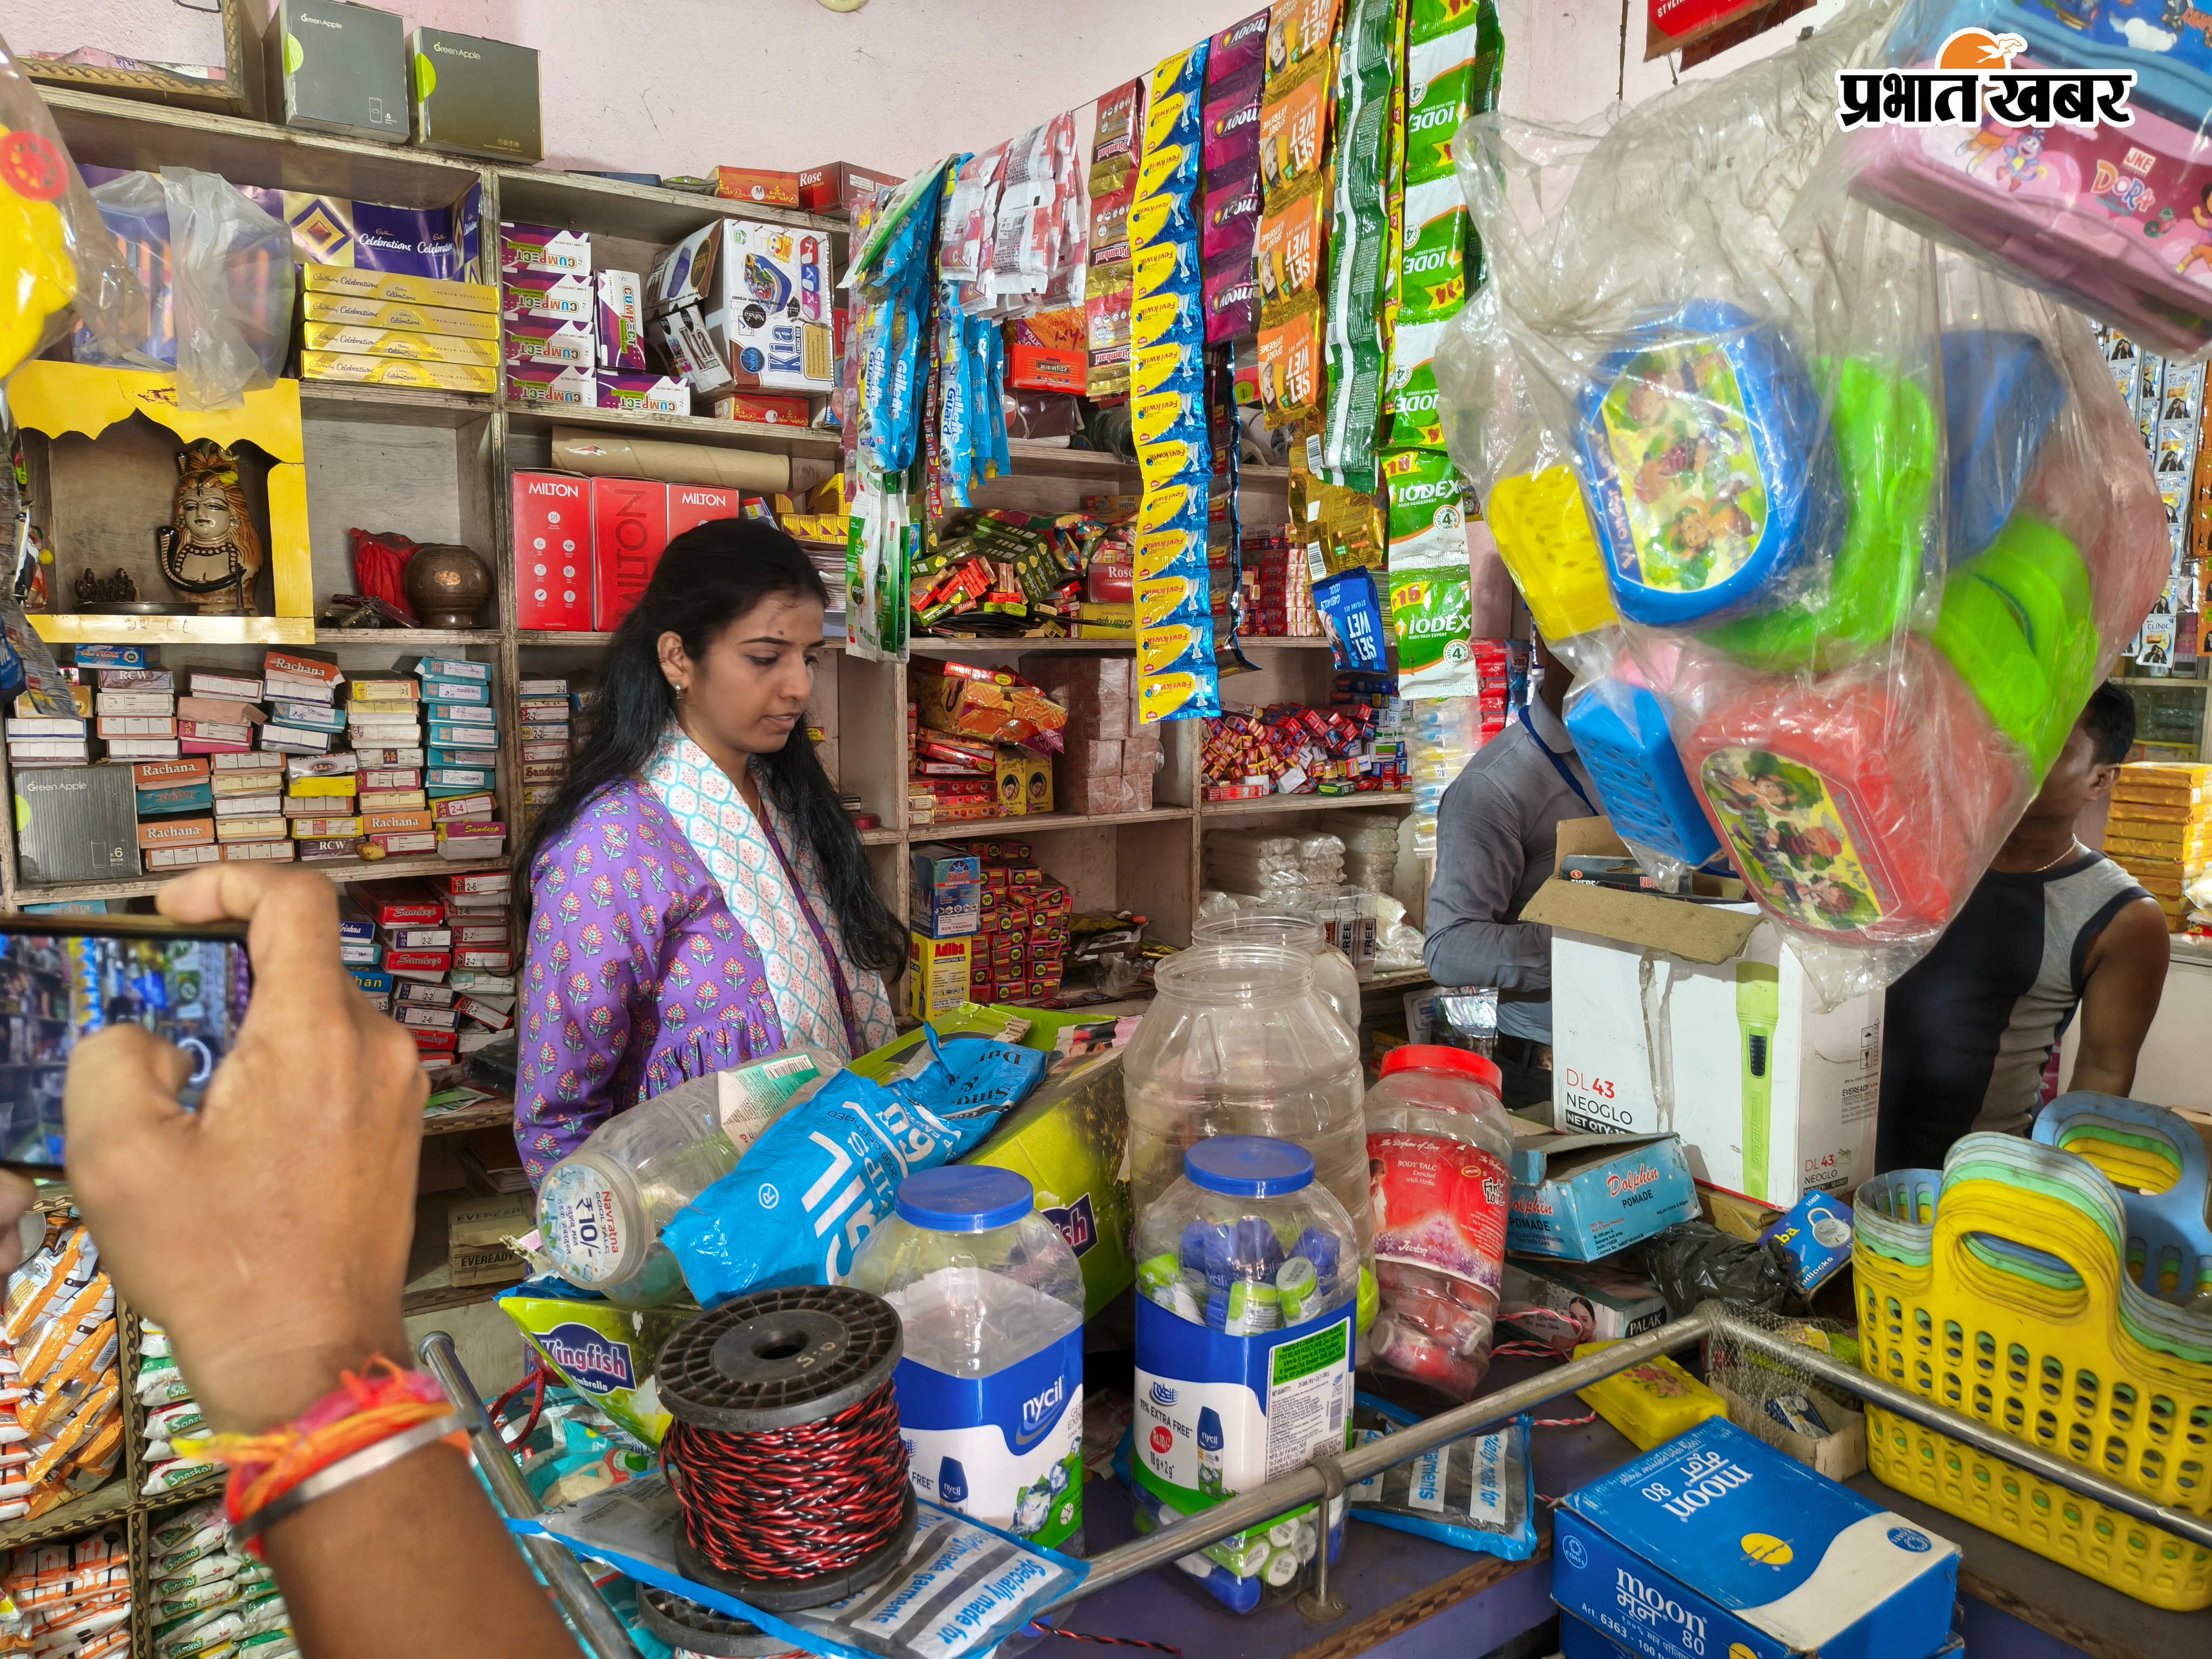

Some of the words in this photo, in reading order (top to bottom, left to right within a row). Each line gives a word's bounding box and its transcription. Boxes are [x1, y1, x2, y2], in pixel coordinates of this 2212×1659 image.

[1224, 108, 1263, 133] moov
[1290, 109, 1317, 146] WET
[1290, 132, 1315, 172] SET
[800, 170, 822, 186] Rose
[2090, 159, 2155, 212] DORA
[359, 233, 412, 252] Celebrations
[1285, 226, 1310, 262] WET
[516, 248, 577, 269] CUMPECT
[340, 276, 380, 289] Celebrations
[1286, 256, 1310, 289] SET
[518, 291, 579, 313] CUMPECT
[1219, 289, 1253, 308] moov
[340, 306, 379, 318] Celebrations
[622, 285, 638, 348] CUMPECT
[340, 335, 378, 346] Celebrations
[519, 339, 579, 360] CUMPECT
[768, 325, 802, 374] Kia
[1266, 344, 1284, 363] SPORT
[1285, 345, 1310, 381] WET
[336, 363, 374, 374] Celebrations
[867, 351, 876, 400] Guard
[869, 346, 886, 409] Gillette
[891, 358, 908, 421] Gillette
[1286, 372, 1310, 403] SET
[619, 394, 677, 413] CUMPECT
[942, 387, 956, 437] Guard
[951, 382, 964, 444] Gillette
[529, 482, 579, 498] MILTON
[682, 492, 726, 507] MILTON
[1399, 480, 1462, 504] IODEX
[1398, 500, 1410, 508] BODY
[1442, 513, 1452, 525] 4
[1109, 566, 1133, 578] Rose
[851, 584, 865, 596] Dettol
[1328, 583, 1341, 593] COOL
[957, 601, 973, 611] Rose
[1347, 610, 1372, 638] WET
[1408, 614, 1472, 635] IODEX
[81, 649, 120, 659] ACTION
[1357, 634, 1378, 662] SET
[1452, 648, 1462, 659] 4
[119, 670, 150, 680] RCW
[276, 657, 325, 677] Rachana
[142, 763, 201, 777] Rachana
[156, 788, 195, 804] संदीप
[450, 801, 465, 813] 2-4
[147, 825, 204, 839] Rachana
[372, 817, 419, 829] Rachana
[465, 824, 500, 834] Sandeep
[319, 840, 346, 850] RCW
[467, 882, 477, 891] 2-6
[948, 872, 969, 882] SUN
[394, 906, 437, 917] Sandeep
[422, 936, 432, 945] 2-2
[935, 942, 965, 957] Adiba
[397, 954, 442, 966] Sandeep
[378, 1001, 388, 1010] 2-2
[423, 993, 434, 1001] 2-2
[1566, 1068, 1589, 1091] DL
[1593, 1078, 1615, 1099] 43
[1566, 1091, 1633, 1125] NEOGLO
[1567, 1111, 1587, 1128] NET
[1397, 1160, 1418, 1169] BODY
[1419, 1163, 1438, 1172] TALC
[1805, 1158, 1819, 1172] DL
[1821, 1154, 1835, 1168] 43
[1412, 1170, 1437, 1179] Enriched
[1606, 1163, 1660, 1197] Dolphin
[1804, 1169, 1838, 1185] NEOGLO
[1621, 1190, 1654, 1210] POMADE
[576, 1197, 601, 1258] ₹10/-
[595, 1191, 605, 1223] COOL
[601, 1226, 610, 1254] TALC
[601, 1191, 619, 1254] Navratna
[1508, 1217, 1552, 1232] POMADE
[461, 1252, 514, 1267] EVEREADY
[1630, 1313, 1662, 1336] PALAK
[541, 1338, 627, 1380] Kingfish
[1022, 1377, 1064, 1422] nycil
[1140, 1398, 1150, 1414] 11%
[1150, 1405, 1172, 1428] EXTRA
[1172, 1419, 1191, 1439] FREE
[1202, 1431, 1218, 1445] nycil
[1150, 1451, 1155, 1466] 18
[1165, 1461, 1169, 1474] 2
[1680, 1451, 1730, 1484] मून
[170, 1463, 213, 1487] Sanskar
[912, 1471, 934, 1491] FREE
[944, 1481, 961, 1497] nycil
[1479, 1487, 1500, 1508] for
[1641, 1482, 1672, 1502] 80
[1661, 1463, 1754, 1519] moon
[167, 1547, 200, 1570] Sanskar
[163, 1577, 197, 1595] Sanskar
[989, 1558, 1047, 1601] Specially
[163, 1599, 198, 1617] Sanskar
[955, 1593, 996, 1626] made
[1616, 1567, 1707, 1641] moon
[1616, 1586, 1663, 1627] मून
[935, 1627, 968, 1645] for
[1581, 1602, 1598, 1620] Art.
[1600, 1613, 1628, 1638] 6363
[1638, 1639, 1656, 1657] 100
[1682, 1629, 1705, 1657] 80
